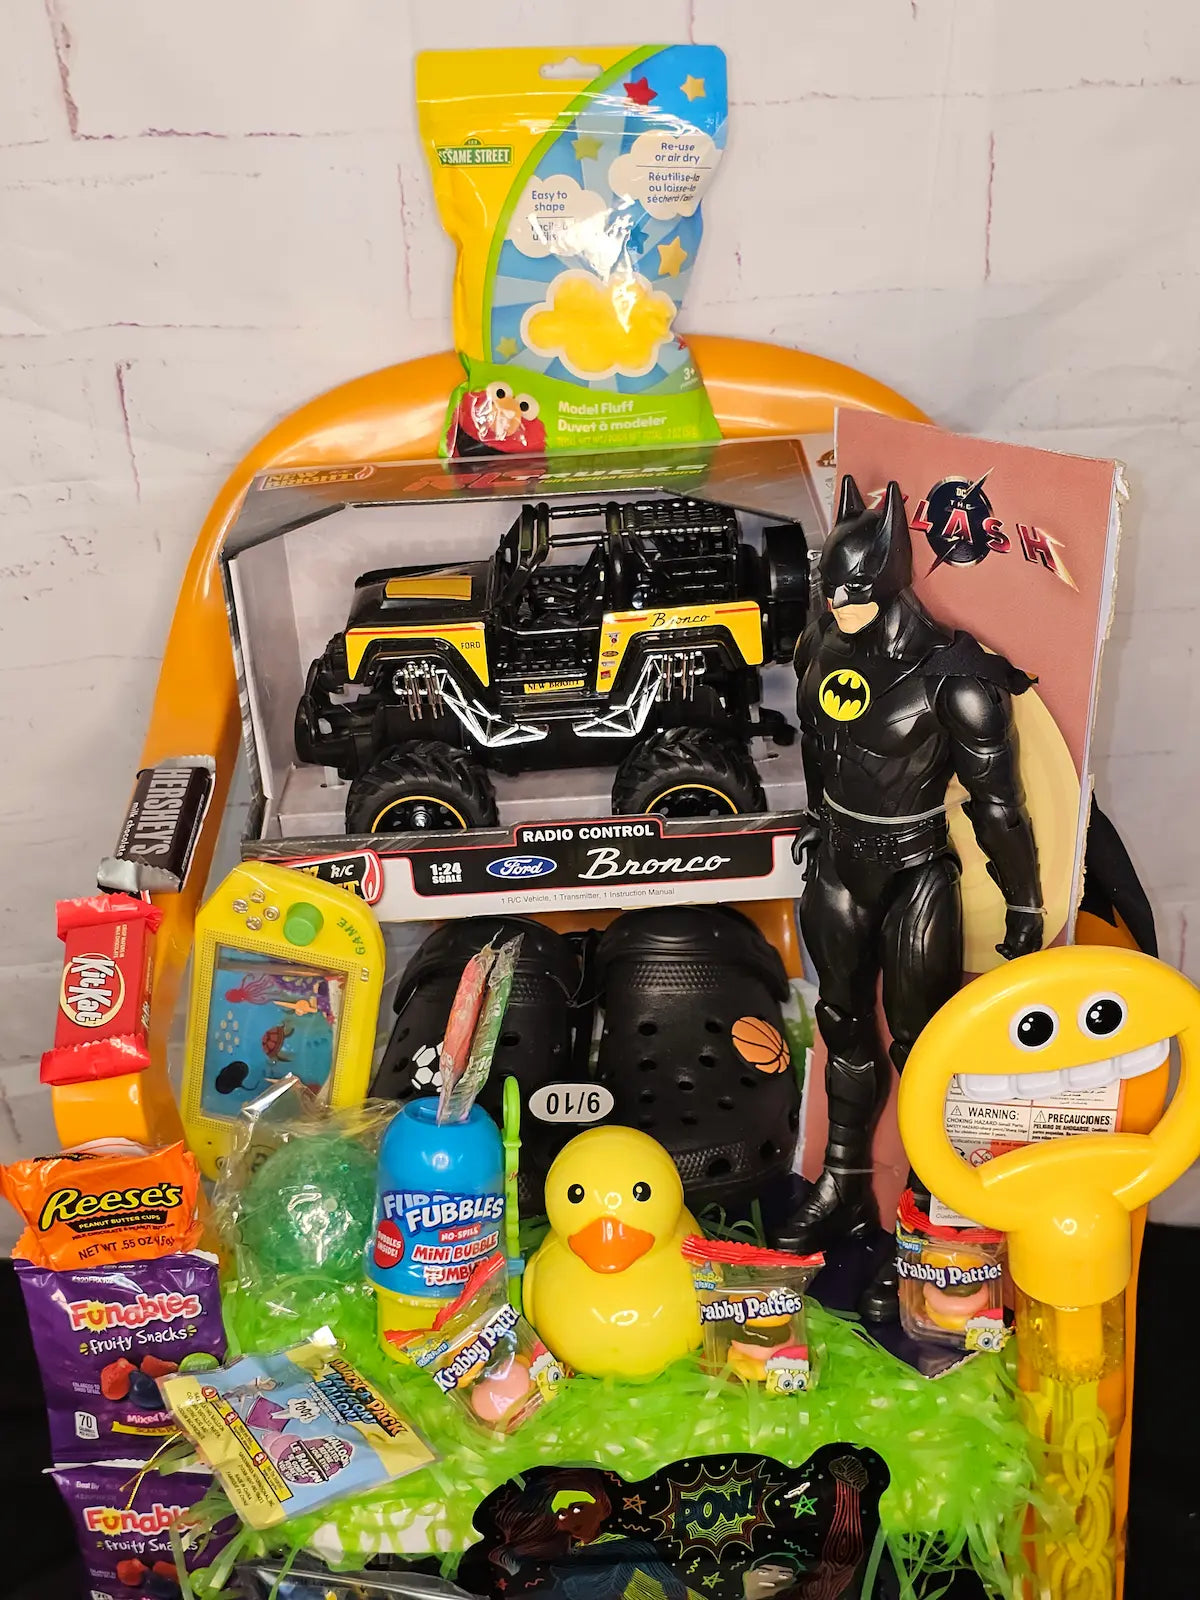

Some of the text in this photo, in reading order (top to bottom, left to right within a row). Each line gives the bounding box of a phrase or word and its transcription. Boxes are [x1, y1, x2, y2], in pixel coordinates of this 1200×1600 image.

[661, 142, 695, 151] Re-use
[475, 148, 511, 163] STREET
[655, 153, 700, 165] or air dry
[532, 190, 568, 201] Easy to
[534, 202, 565, 213] shape
[558, 400, 634, 415] Model Fluff
[558, 419, 596, 432] Duvet
[610, 416, 668, 431] modeler
[948, 499, 972, 509] THE
[461, 642, 481, 650] FORD
[130, 768, 192, 855] HERSHEY'S
[116, 801, 140, 857] milk chocolate
[522, 824, 654, 843] RADIO CONTROL
[330, 864, 354, 879] R/C
[430, 863, 462, 876] 1:24
[499, 859, 543, 876] Ford
[578, 847, 730, 880] Bronco
[432, 875, 462, 884] SCALE
[507, 896, 521, 904] R/C
[521, 894, 552, 904] Vehicle,
[559, 892, 601, 901] Transmitter,
[609, 889, 647, 899] Instruction
[648, 888, 675, 897] Manual
[336, 917, 366, 955] GAME
[968, 1106, 1020, 1120] WARNING:
[1048, 1113, 1113, 1126] PRECAUCIONES:
[38, 1182, 183, 1232] Reese's
[405, 1197, 504, 1232] FUBBLES
[79, 1219, 110, 1229] PEANUT
[110, 1216, 140, 1225] BUTTER
[78, 1236, 152, 1260] NET WT .55 OZ
[453, 1233, 498, 1259] BUBBLE
[71, 1293, 200, 1329] Funables
[701, 1294, 802, 1325] rabby Patties
[135, 1327, 187, 1345] Snacks
[432, 1340, 489, 1393] Krabby
[79, 1414, 93, 1429] 70
[127, 1414, 159, 1424] Mixed
[289, 1442, 323, 1483] LE BALLON
